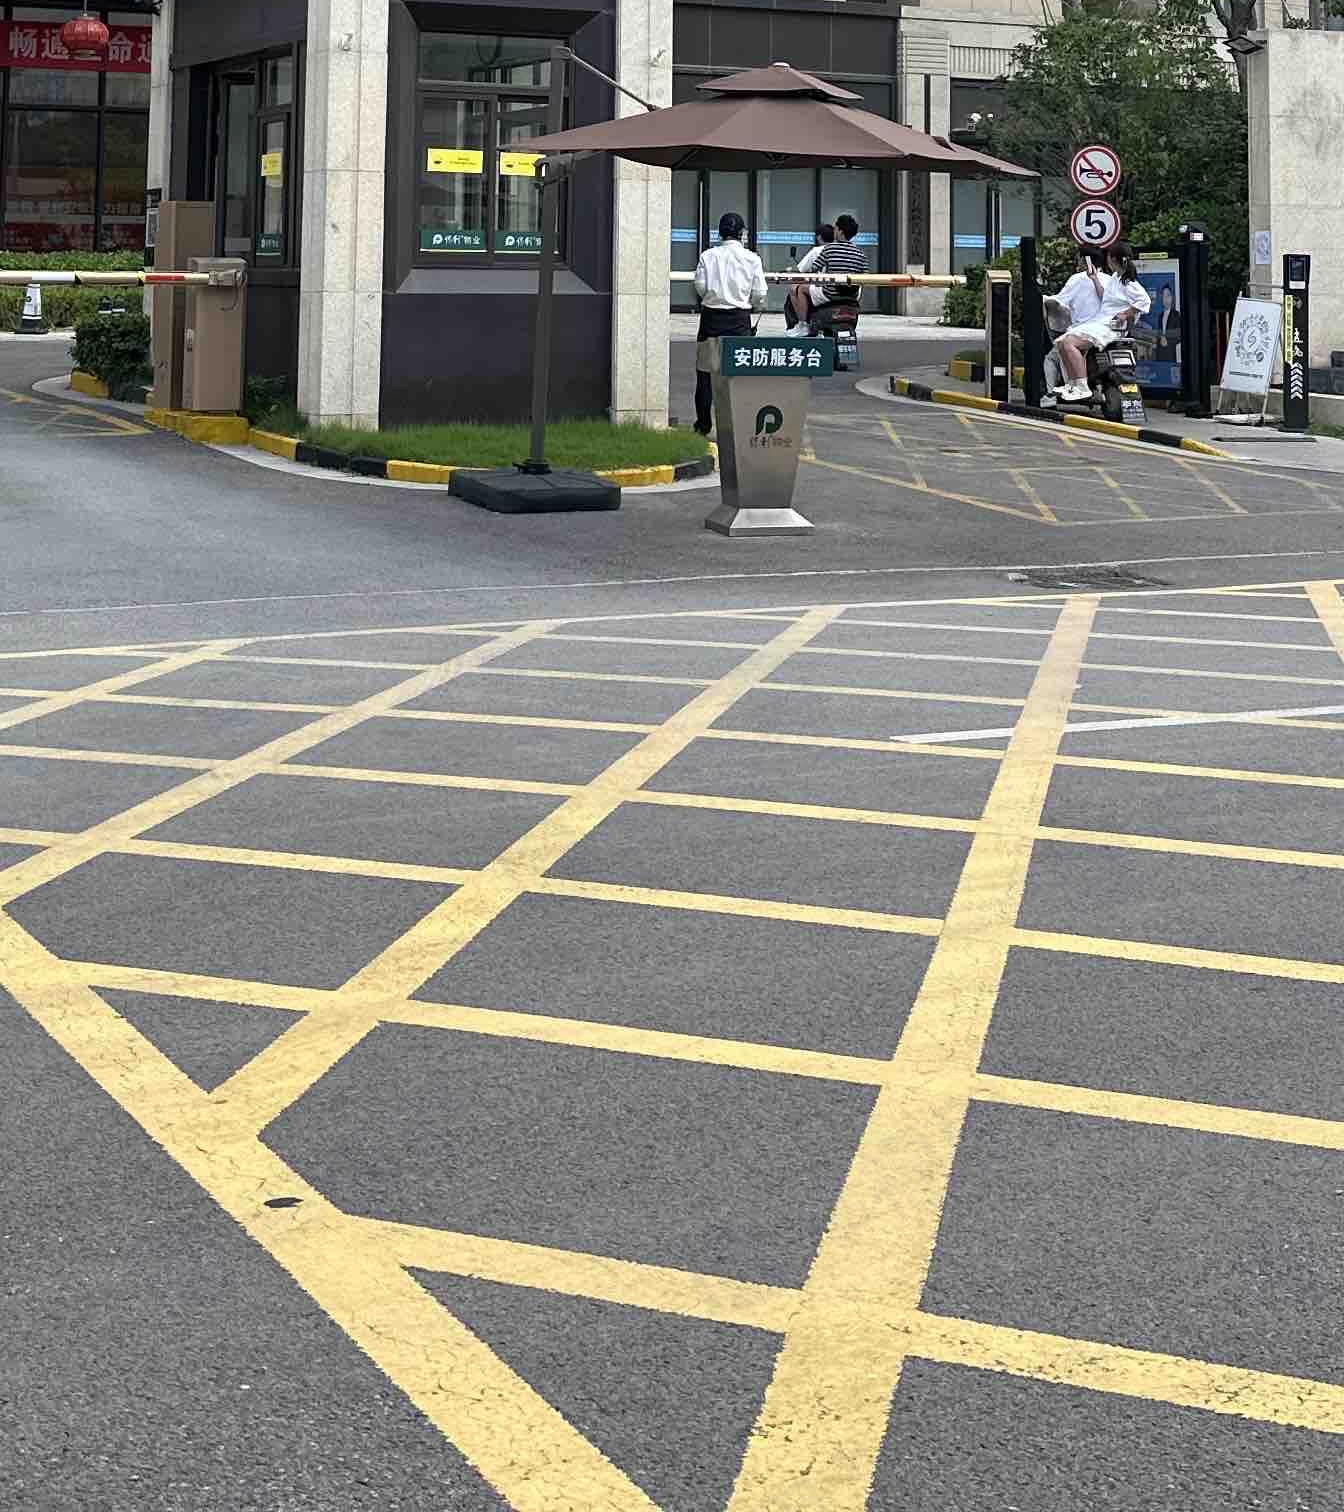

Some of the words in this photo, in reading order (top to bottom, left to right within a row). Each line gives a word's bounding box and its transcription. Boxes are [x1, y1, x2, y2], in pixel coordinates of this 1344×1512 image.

[8, 25, 153, 64] 畅通命
[1085, 209, 1106, 240] 5
[734, 347, 823, 368] 安防服务台
